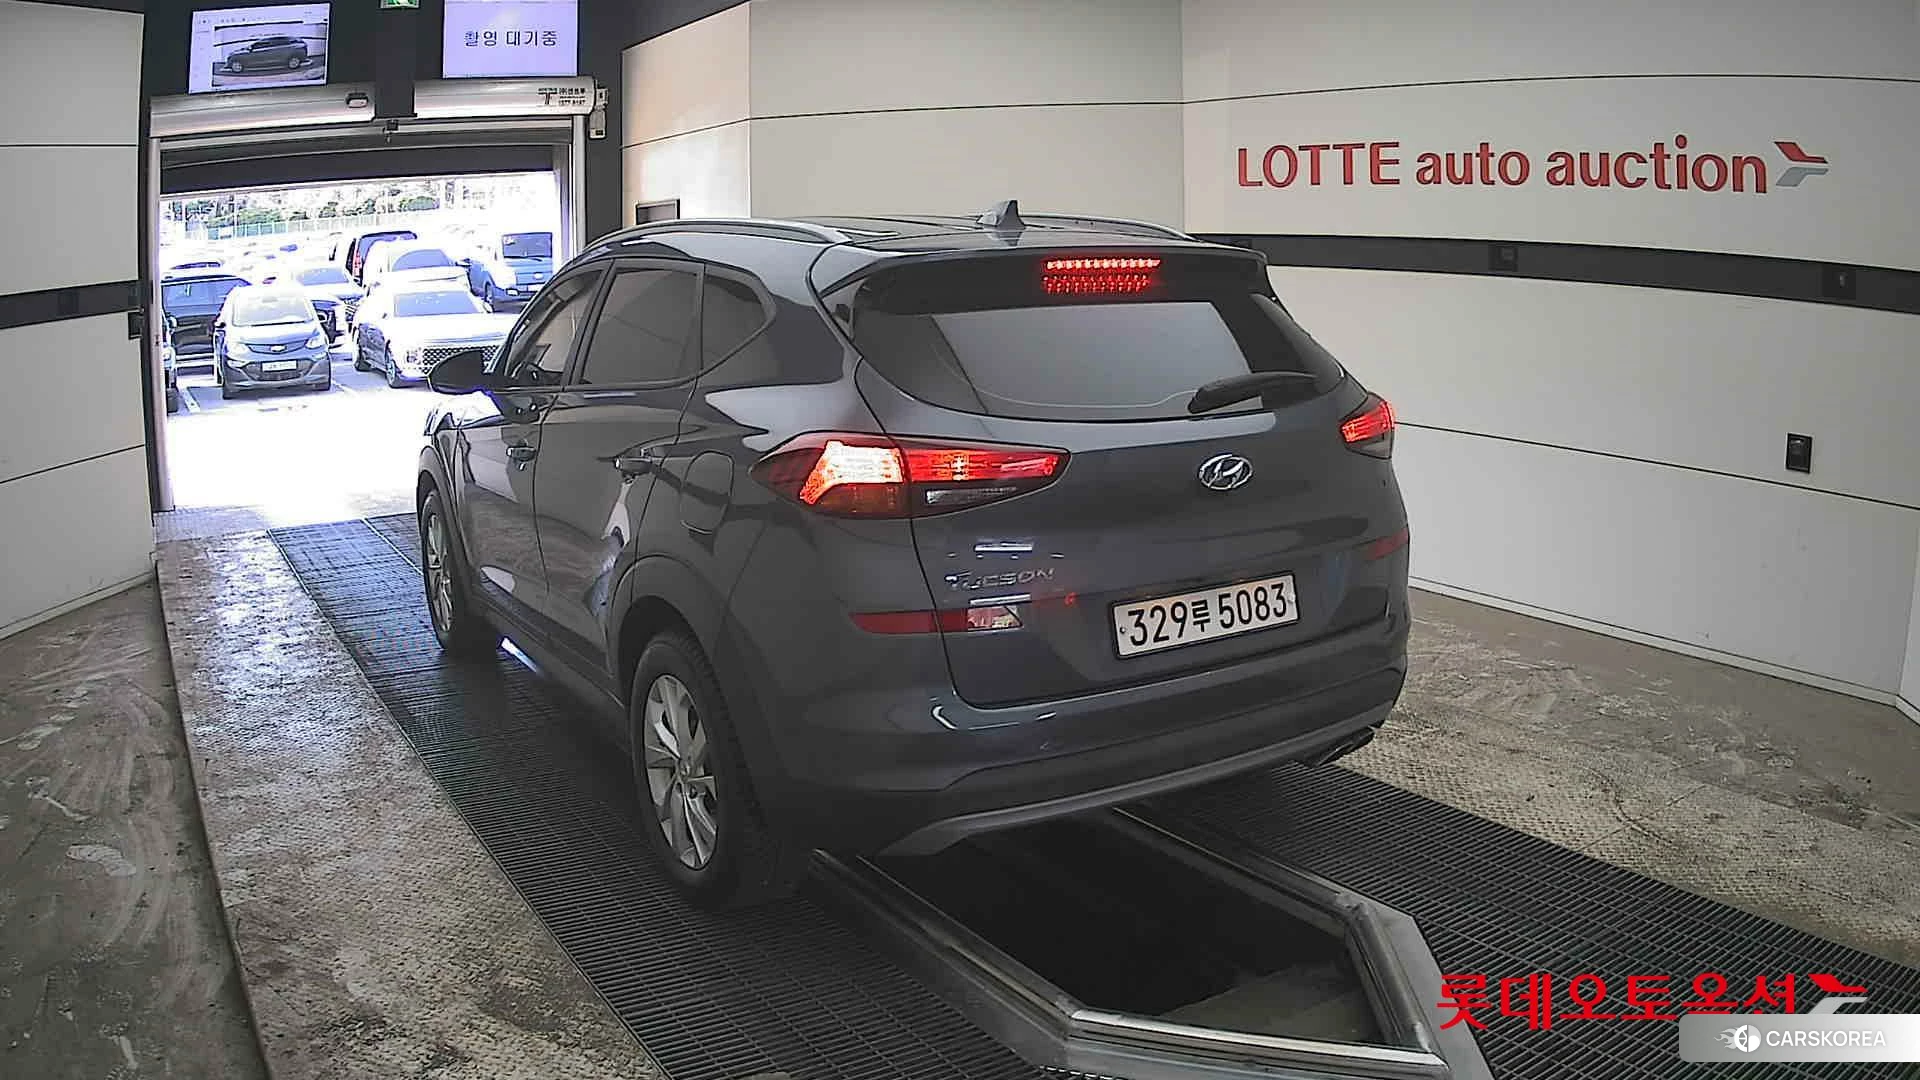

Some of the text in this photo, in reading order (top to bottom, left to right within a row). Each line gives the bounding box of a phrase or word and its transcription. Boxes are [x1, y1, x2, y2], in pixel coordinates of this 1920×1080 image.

[506, 30, 558, 47] 대기중
[1238, 135, 1768, 194] LOTTE auto auction
[1127, 582, 1287, 647] 329루 5083
